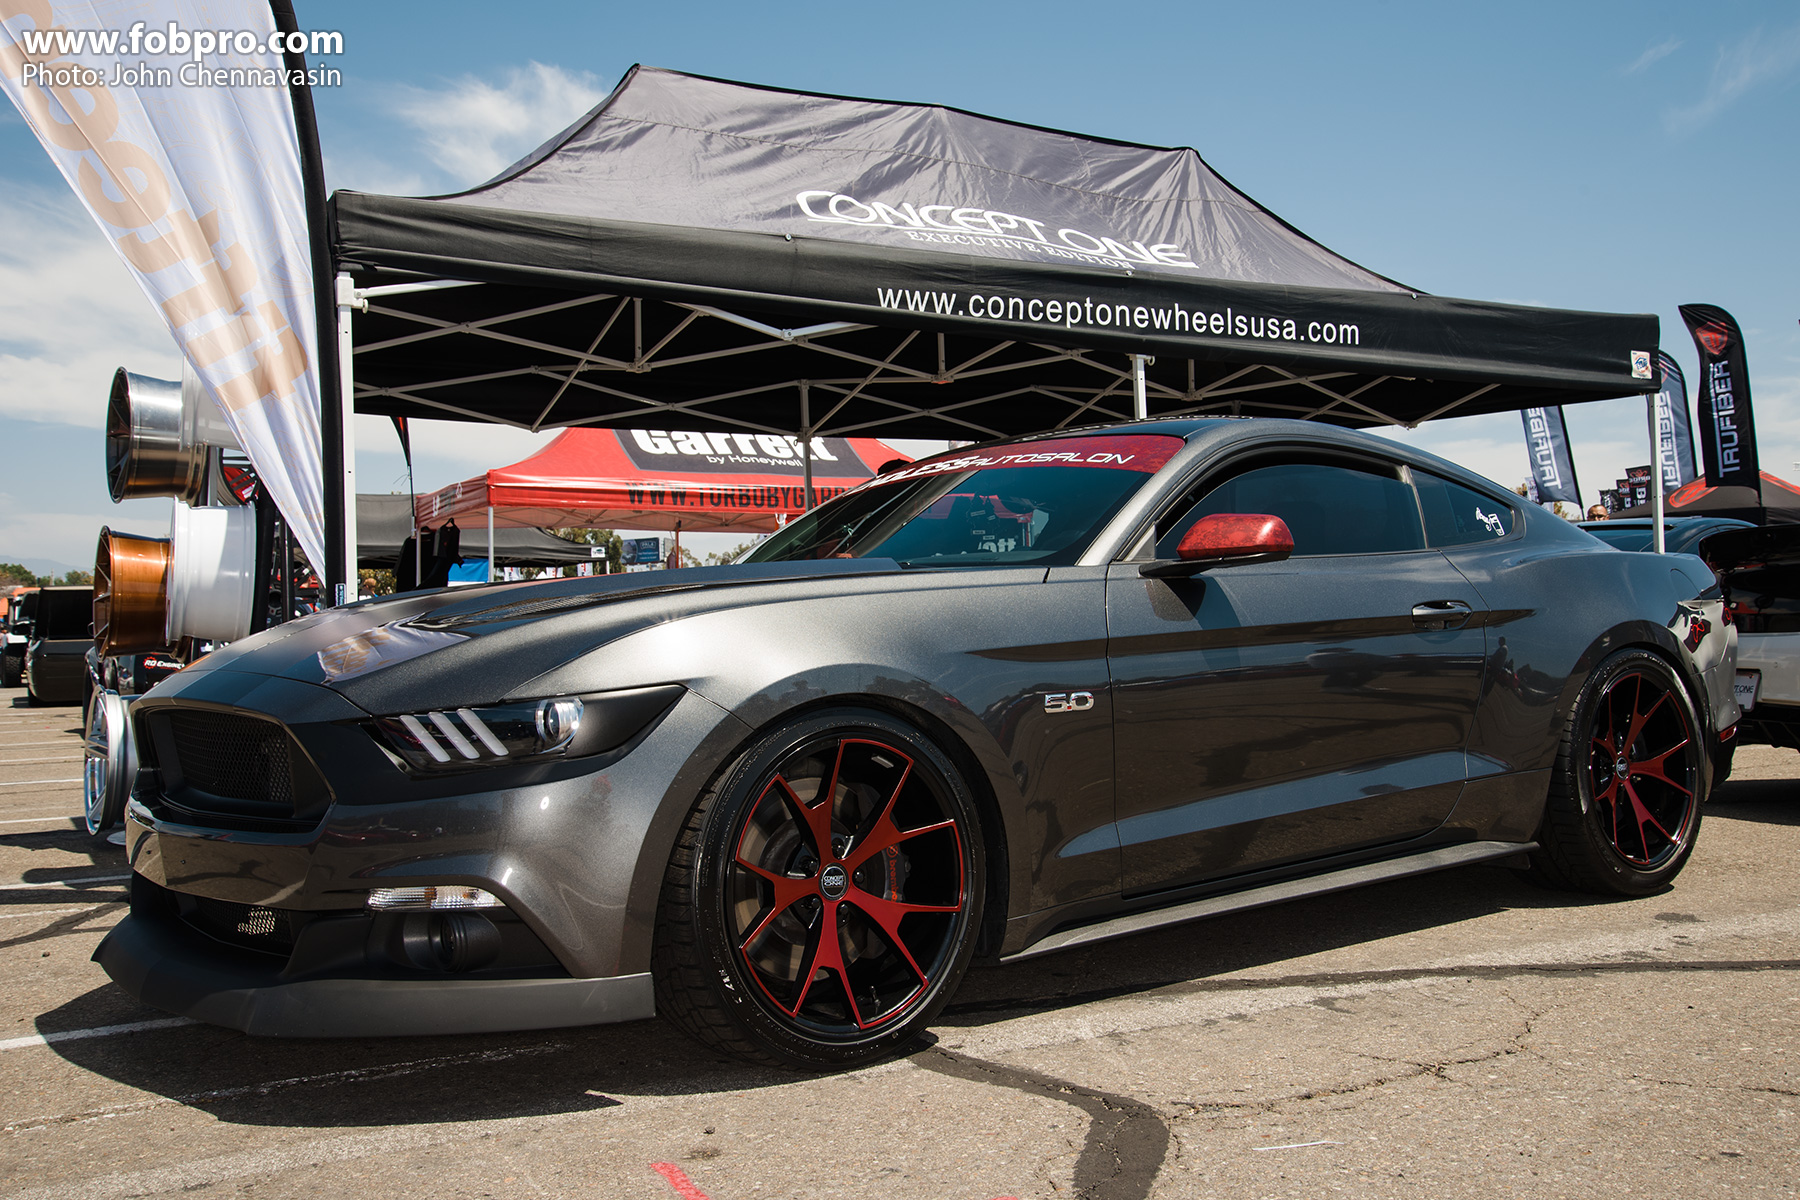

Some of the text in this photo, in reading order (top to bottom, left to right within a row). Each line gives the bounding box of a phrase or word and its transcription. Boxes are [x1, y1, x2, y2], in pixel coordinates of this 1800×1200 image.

[796, 190, 1200, 269] CONCEPT ONE
[904, 230, 1136, 270] EXECUTIVE EDITION
[876, 286, 1360, 346] www.conceptonewheelsusa.com
[1709, 360, 1741, 478] TRUFIBER
[706, 455, 803, 467] by Honeywell
[1044, 691, 1095, 714] 5.0
